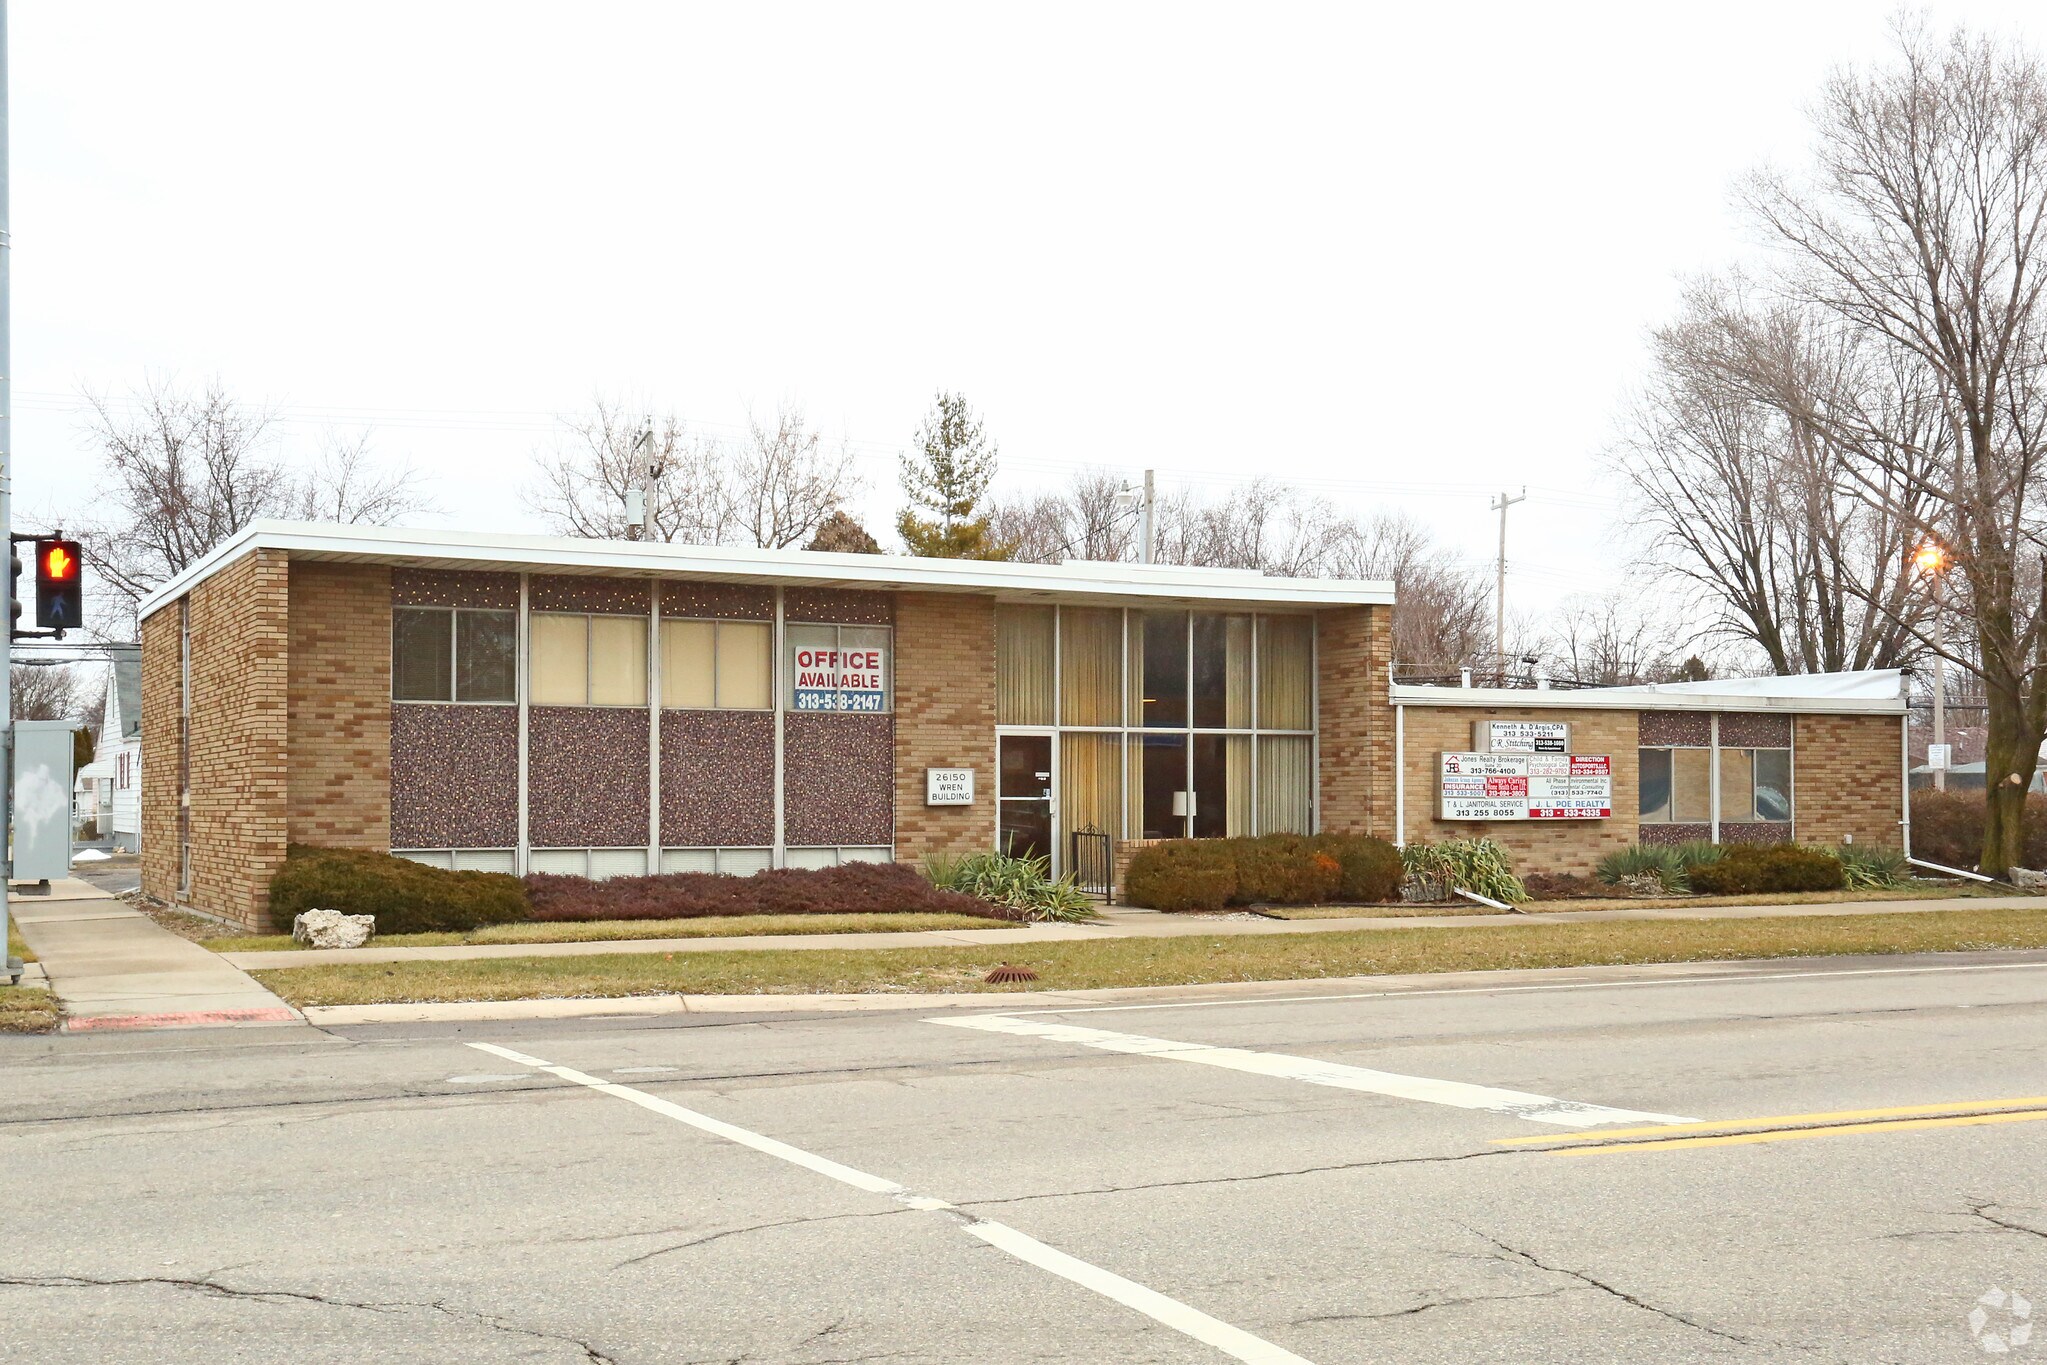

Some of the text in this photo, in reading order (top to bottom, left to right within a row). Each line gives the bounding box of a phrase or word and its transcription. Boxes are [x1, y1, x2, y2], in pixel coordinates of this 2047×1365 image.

[798, 651, 879, 669] OFFICE
[799, 672, 879, 688] AVAILABLE
[1505, 738, 1534, 750] Stitching
[1498, 756, 1524, 764] Brokerage
